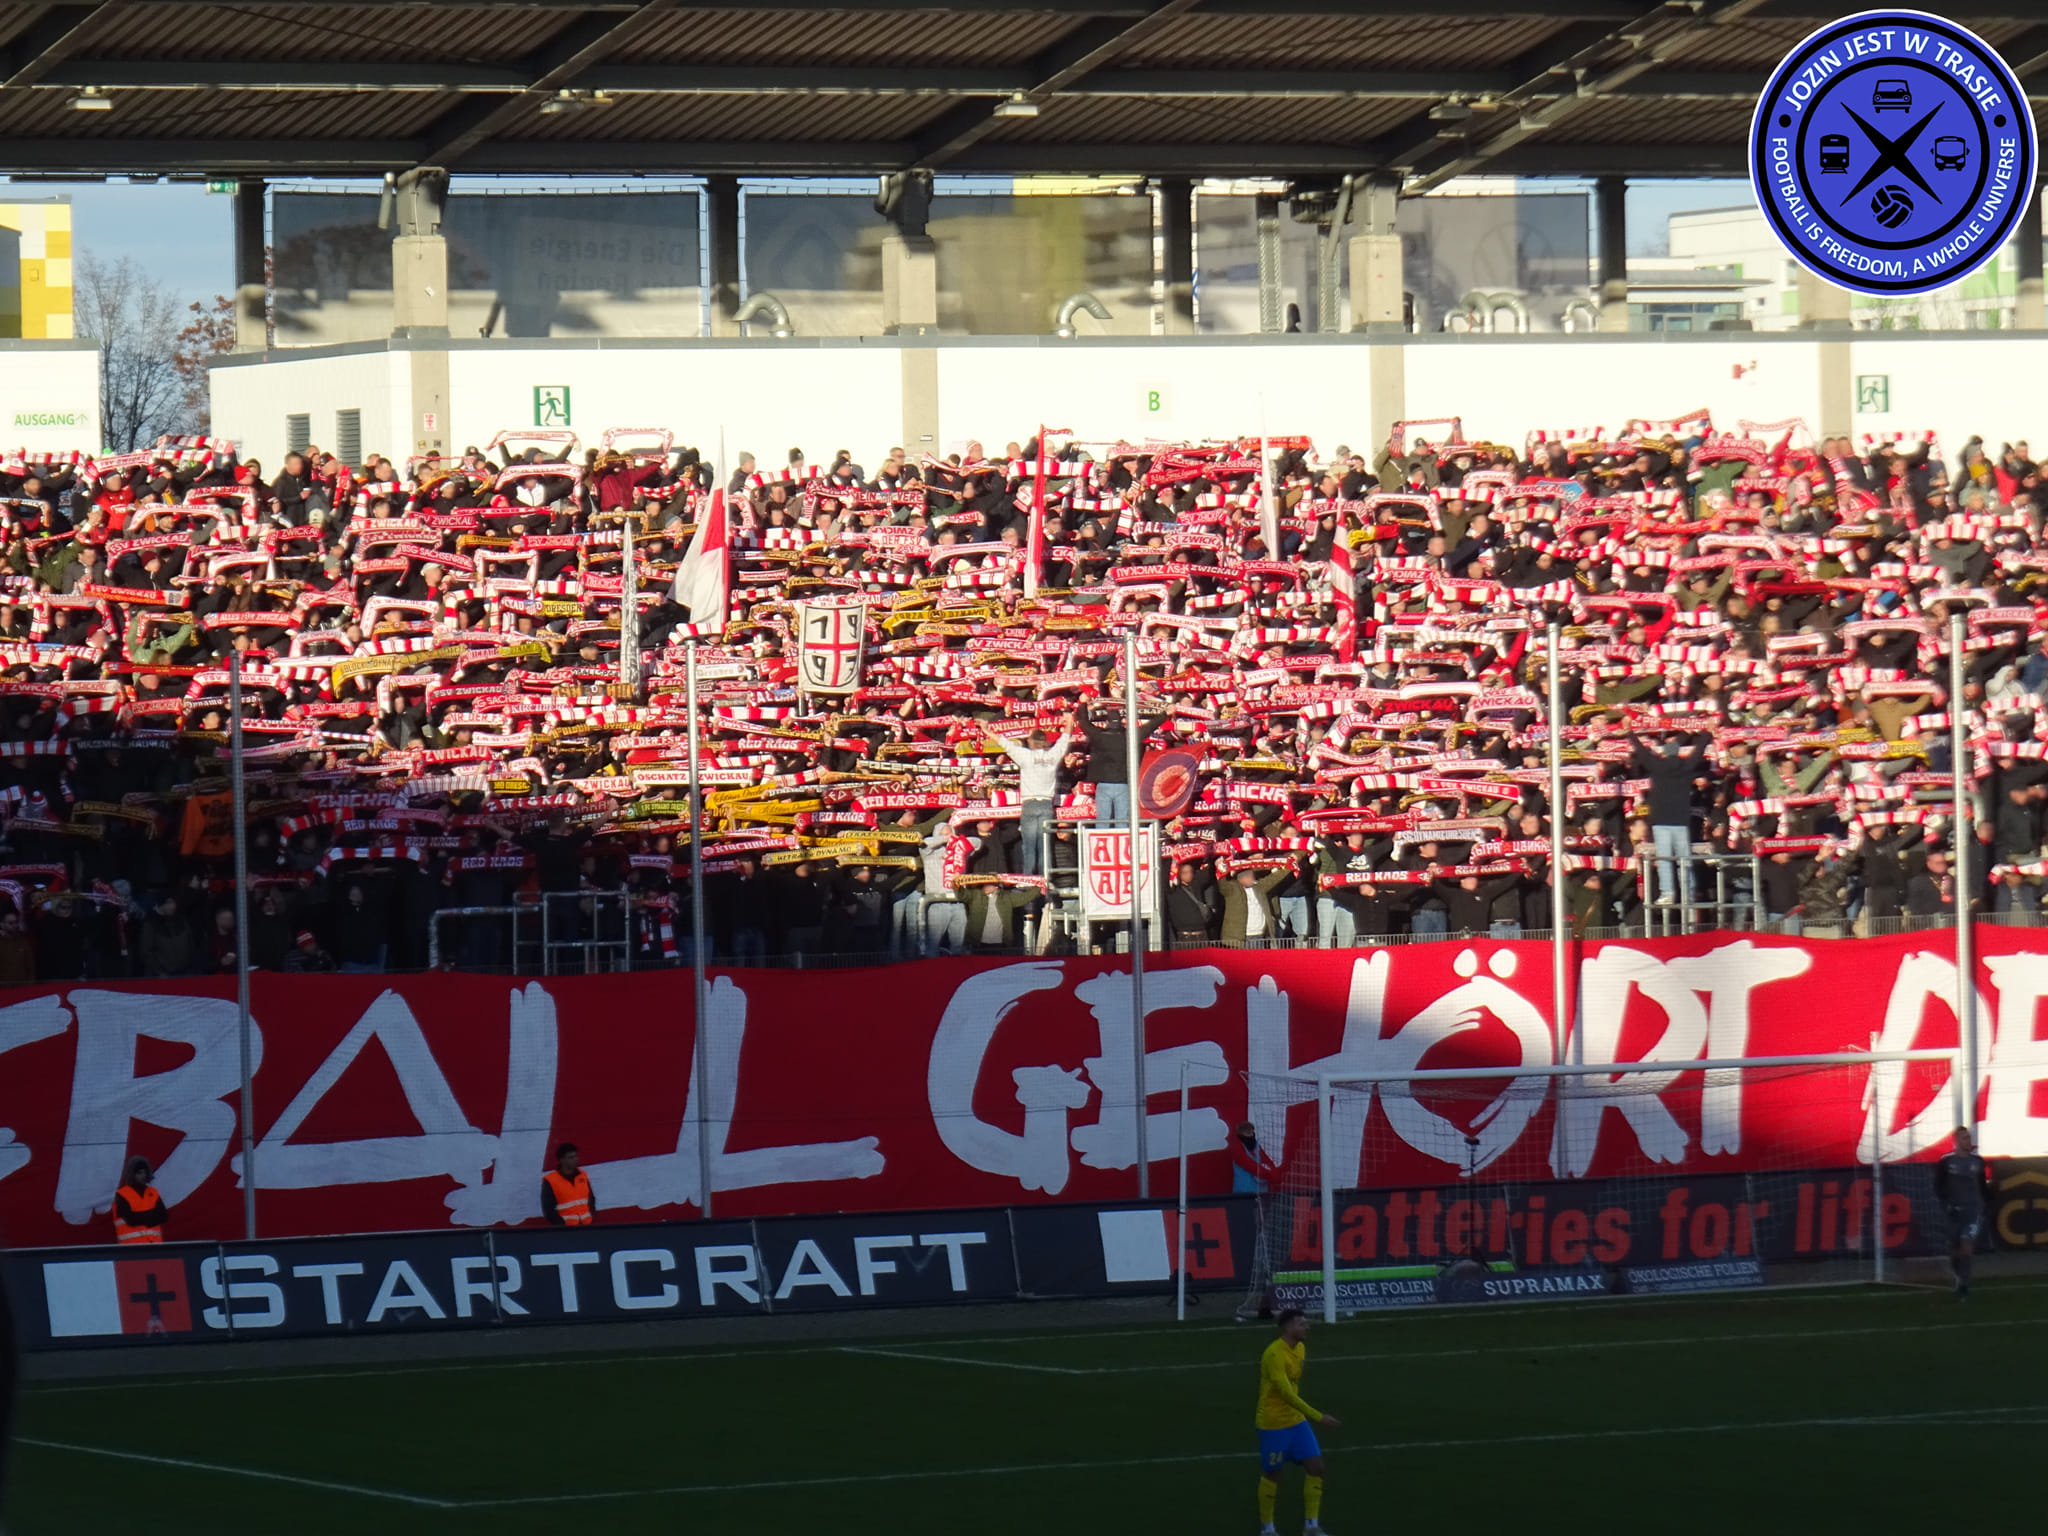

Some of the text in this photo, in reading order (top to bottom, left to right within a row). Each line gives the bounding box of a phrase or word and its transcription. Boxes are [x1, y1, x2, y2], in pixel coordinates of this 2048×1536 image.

[1148, 391, 1161, 411] B
[14, 413, 76, 427] AUSGANG
[371, 517, 418, 529] ZWICKAU
[431, 515, 474, 526] ZWICKAU
[110, 533, 191, 554] FSV ZWICKAU
[400, 544, 418, 556] BSG
[1116, 566, 1187, 578] FSV ZWICKAU
[1190, 565, 1239, 577] ZWICKAU
[110, 587, 157, 600] ZWICKAU
[219, 612, 243, 625] ALLES
[254, 612, 289, 623] ZWICKAU
[810, 615, 828, 639] 1
[811, 655, 827, 681] 9
[455, 686, 502, 695] ZWICKAU
[1163, 680, 1230, 691] ZWICKAU
[1384, 699, 1451, 712] ZWICKAU
[737, 738, 798, 750] RED KAOS
[424, 746, 487, 762] ZWICKAU
[637, 772, 750, 781] OSCHATZ ZWICKAU
[583, 778, 631, 790] ZWICKAU
[1460, 784, 1499, 794] ZWICKAU
[887, 793, 927, 806] KAOS
[811, 812, 866, 823] RED KAOS
[715, 838, 784, 854] KIRCHBERG
[461, 855, 525, 869] RED KAOS
[1454, 861, 1512, 876] RED KAOS
[1345, 871, 1409, 883] RED KAOS
[926, 938, 1813, 1197] GEHÖRT
[1289, 1189, 1632, 1266] batteries
[1659, 1187, 1770, 1260] for
[1794, 1178, 1912, 1252] life
[199, 1231, 988, 1330] STARTCRAFT
[1483, 1273, 1606, 1297] SUPRAMAX
[1274, 1279, 1435, 1301] ÖKOLOISCHE FOLIEN
[1269, 1451, 1283, 1466] 24
